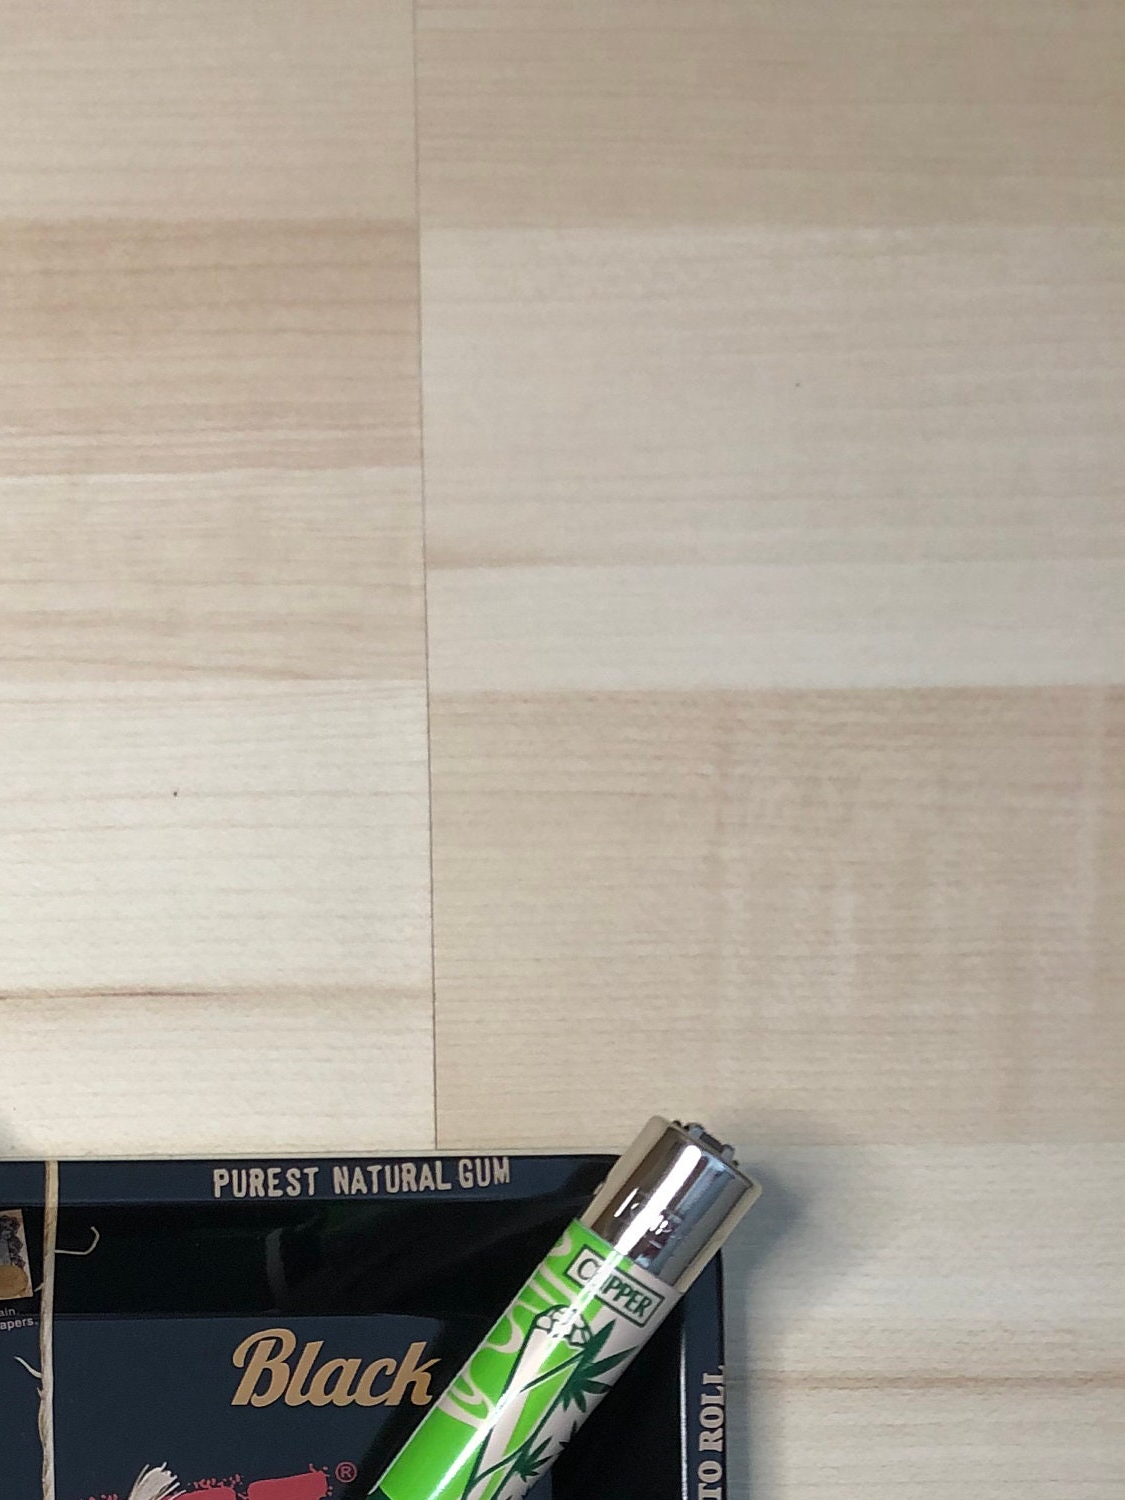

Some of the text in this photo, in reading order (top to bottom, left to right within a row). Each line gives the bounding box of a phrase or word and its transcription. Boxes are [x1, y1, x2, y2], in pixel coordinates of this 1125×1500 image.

[213, 1156, 511, 1198] PUREST NATURAL GUM
[231, 1327, 442, 1408] Black
[698, 1364, 725, 1452] ROLL
